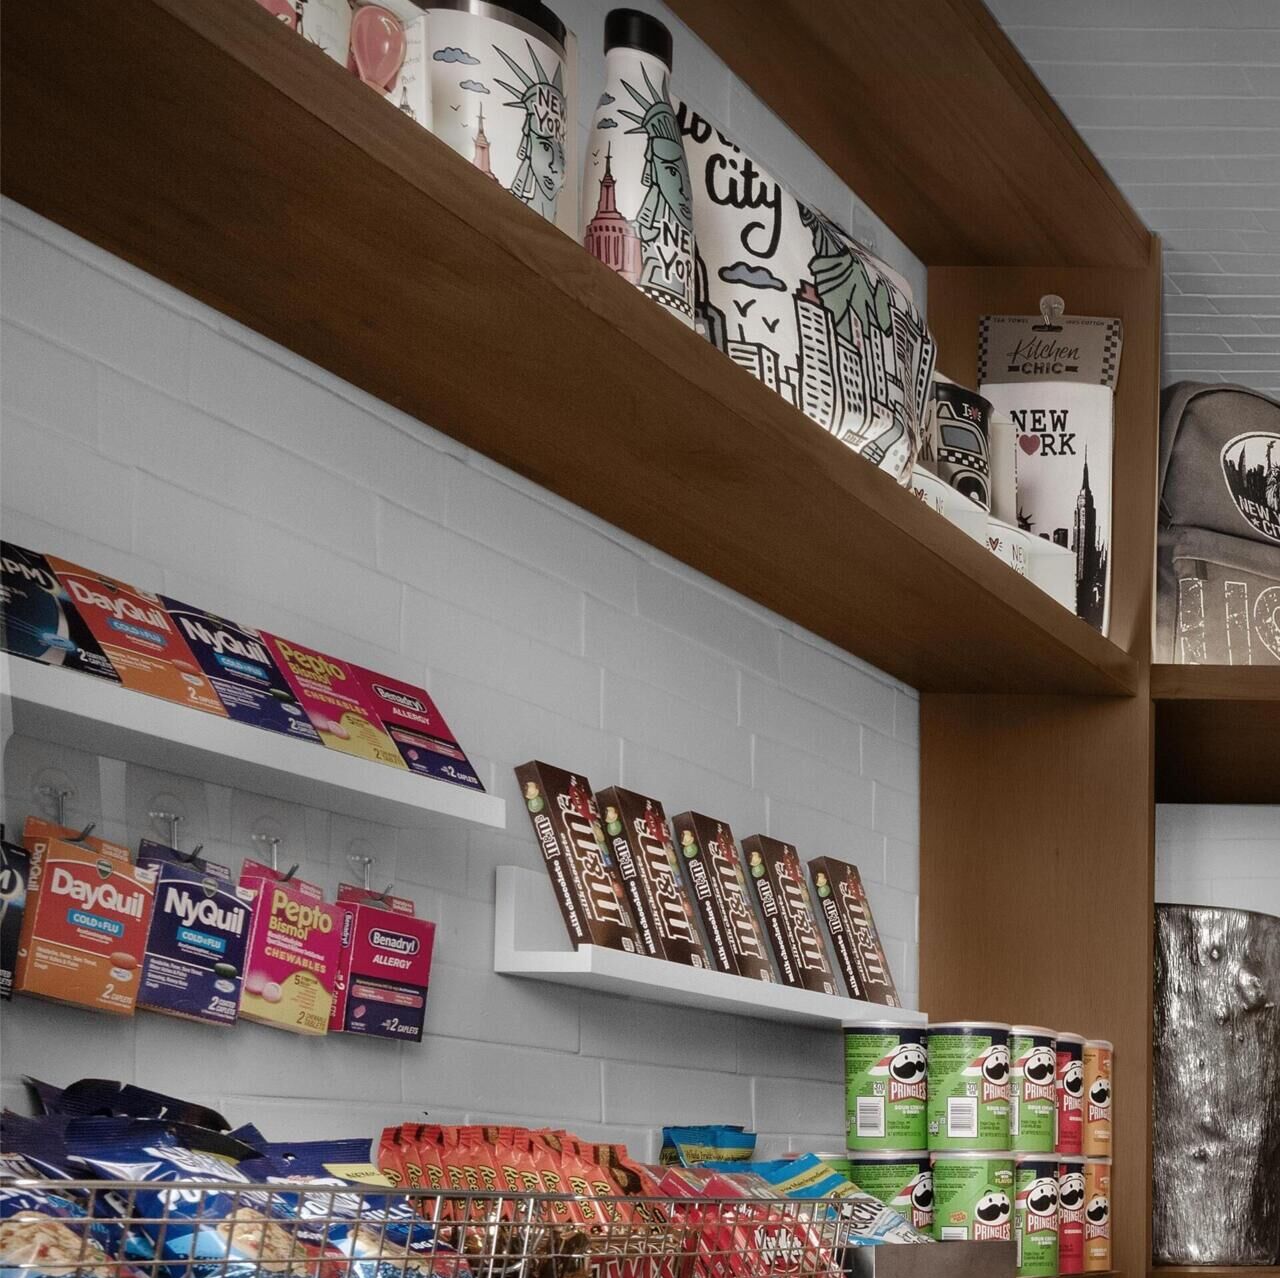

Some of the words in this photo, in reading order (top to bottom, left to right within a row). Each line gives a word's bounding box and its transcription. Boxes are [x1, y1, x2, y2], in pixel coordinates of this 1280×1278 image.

[705, 153, 782, 259] City
[1007, 336, 1080, 362] Kitchen
[1010, 409, 1069, 433] NEW
[1239, 495, 1268, 517] NEW
[67, 579, 172, 634] DayQuil
[179, 616, 271, 668] NyQuil
[275, 639, 346, 681] Pepto
[28, 843, 47, 892] DayQuil
[51, 868, 144, 919] DayQuil
[73, 913, 98, 927] COLD
[164, 887, 244, 935] NyQuil
[271, 890, 332, 933] Pepto
[183, 931, 203, 944] COLD
[269, 915, 309, 941] Bismol
[373, 932, 416, 954] Benadryl
[264, 946, 327, 974] CHEWABLES
[372, 954, 413, 970] ALLERGY
[102, 983, 113, 999] 2
[209, 996, 219, 1010] 2
[296, 1011, 305, 1024] 2
[389, 1018, 398, 1031] 2
[890, 1081, 927, 1100] PRINGLES
[975, 1223, 1010, 1240] PRINGLES
